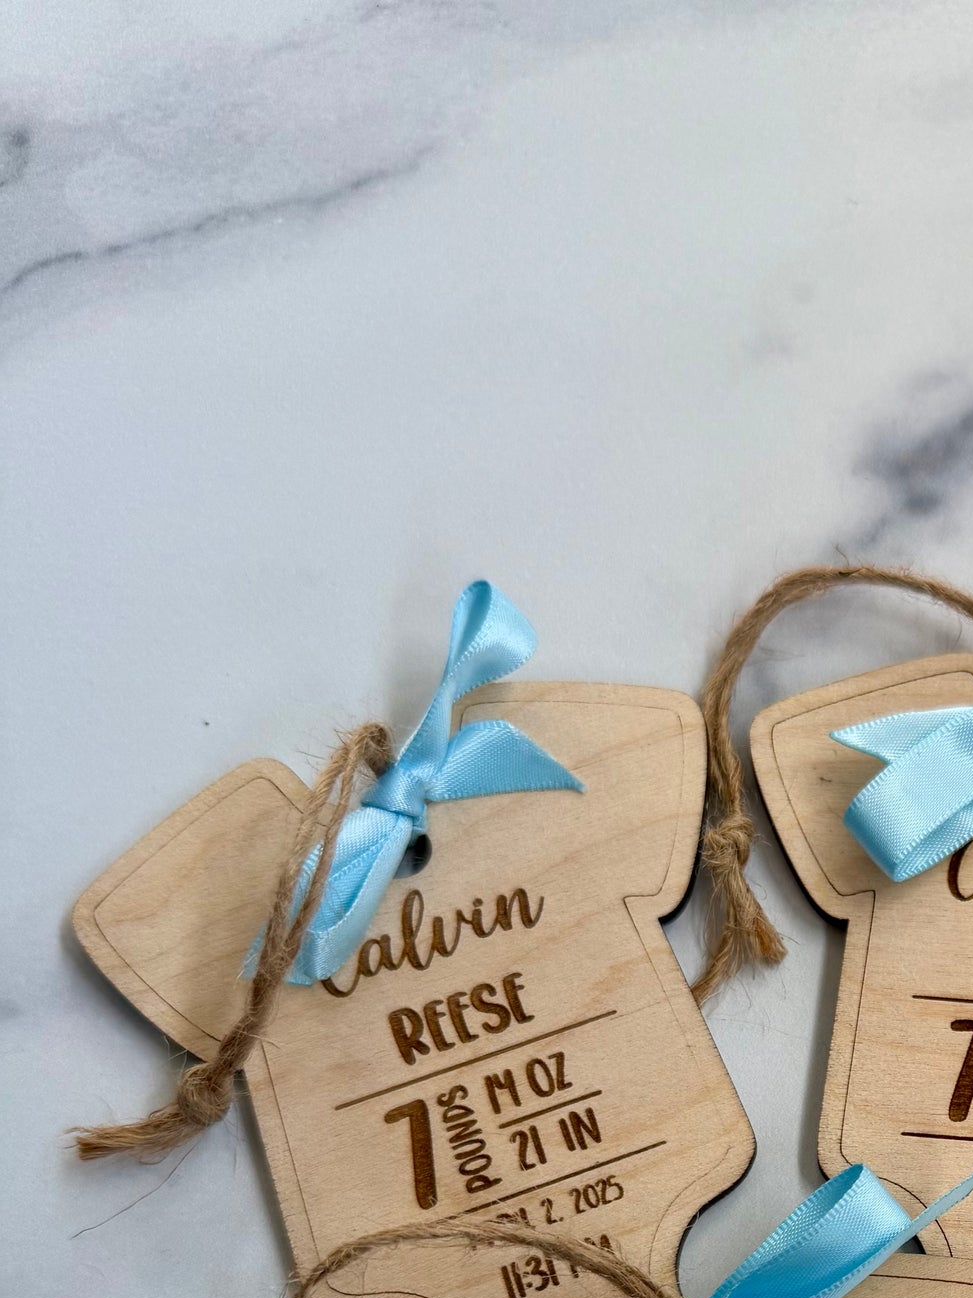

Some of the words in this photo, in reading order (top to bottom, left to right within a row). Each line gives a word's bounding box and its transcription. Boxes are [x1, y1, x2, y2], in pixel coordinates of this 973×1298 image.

[388, 972, 535, 1066] REESE
[526, 1051, 573, 1098] OZ
[384, 1099, 439, 1210] 7
[437, 1084, 502, 1194] POUNDS
[509, 1125, 548, 1171] 21
[559, 1107, 602, 1152] IN
[568, 1174, 625, 1215] 2025
